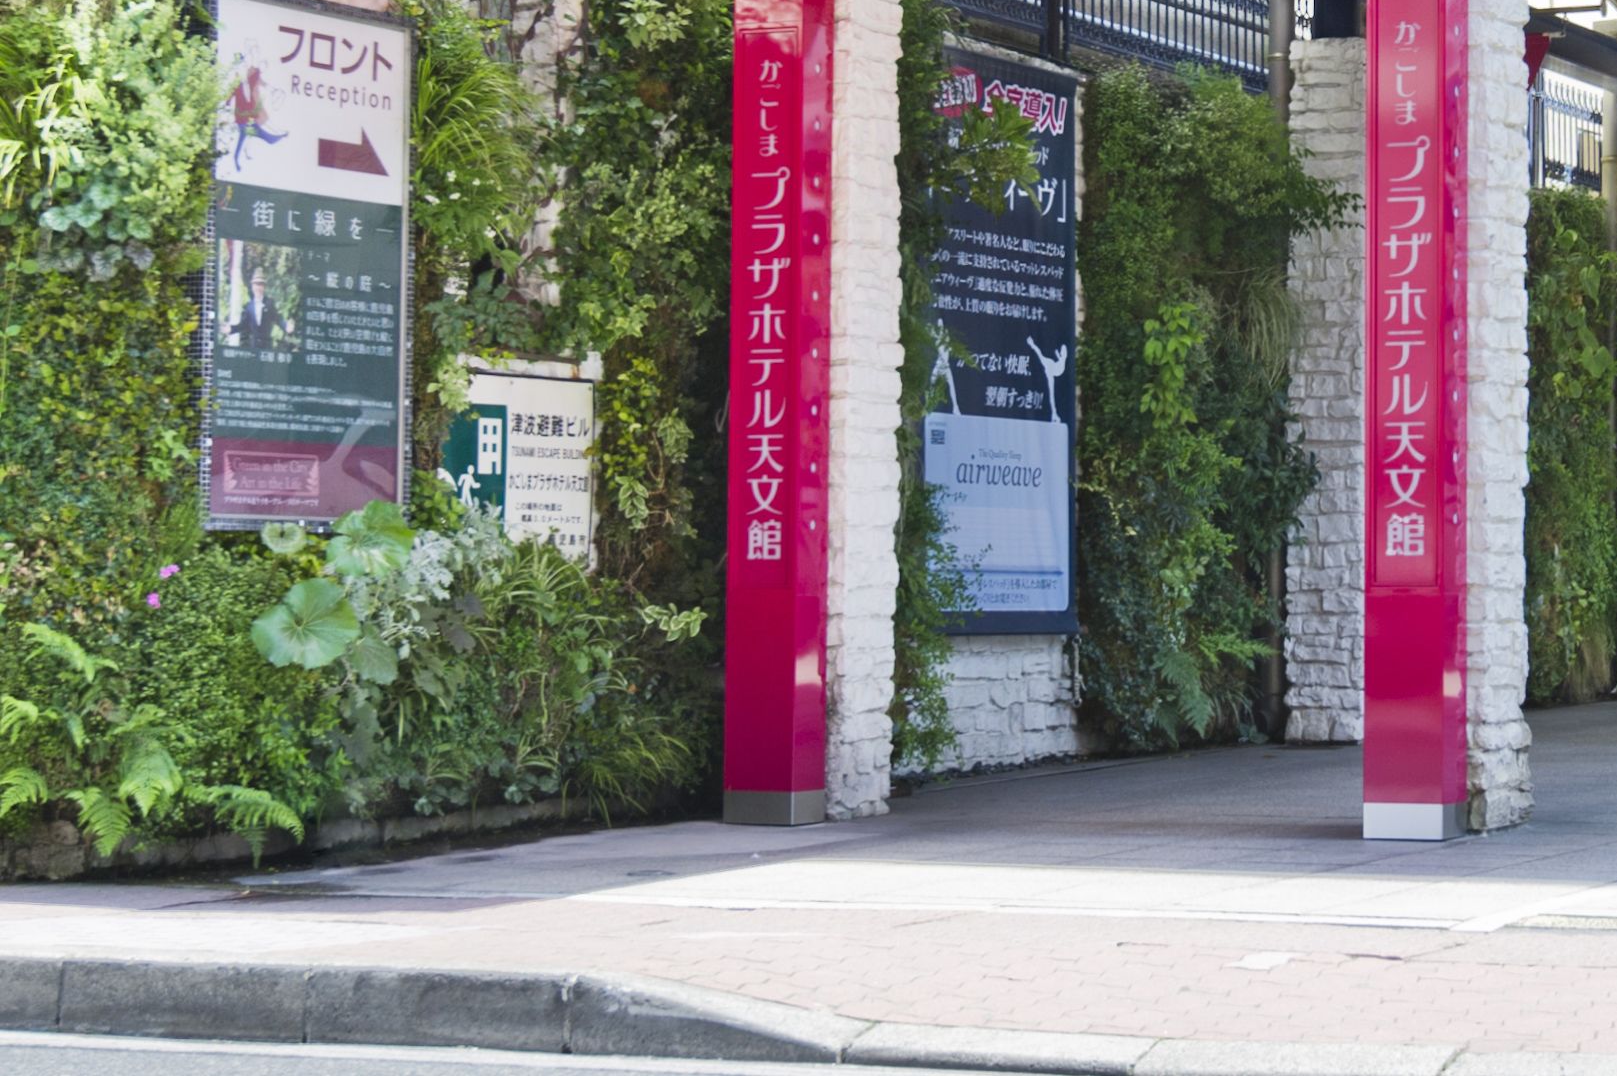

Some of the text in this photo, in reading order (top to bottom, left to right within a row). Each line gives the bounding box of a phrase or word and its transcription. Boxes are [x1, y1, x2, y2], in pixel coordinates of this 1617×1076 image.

[278, 24, 393, 82] フロント
[1394, 20, 1422, 126] かごしま
[291, 74, 392, 111] Reception
[758, 58, 783, 157] かごしま
[511, 412, 590, 438] 津波避難ビル
[511, 446, 535, 457] TSUNAMI
[537, 447, 561, 459] ESCAPE
[956, 454, 1042, 488] airweave
